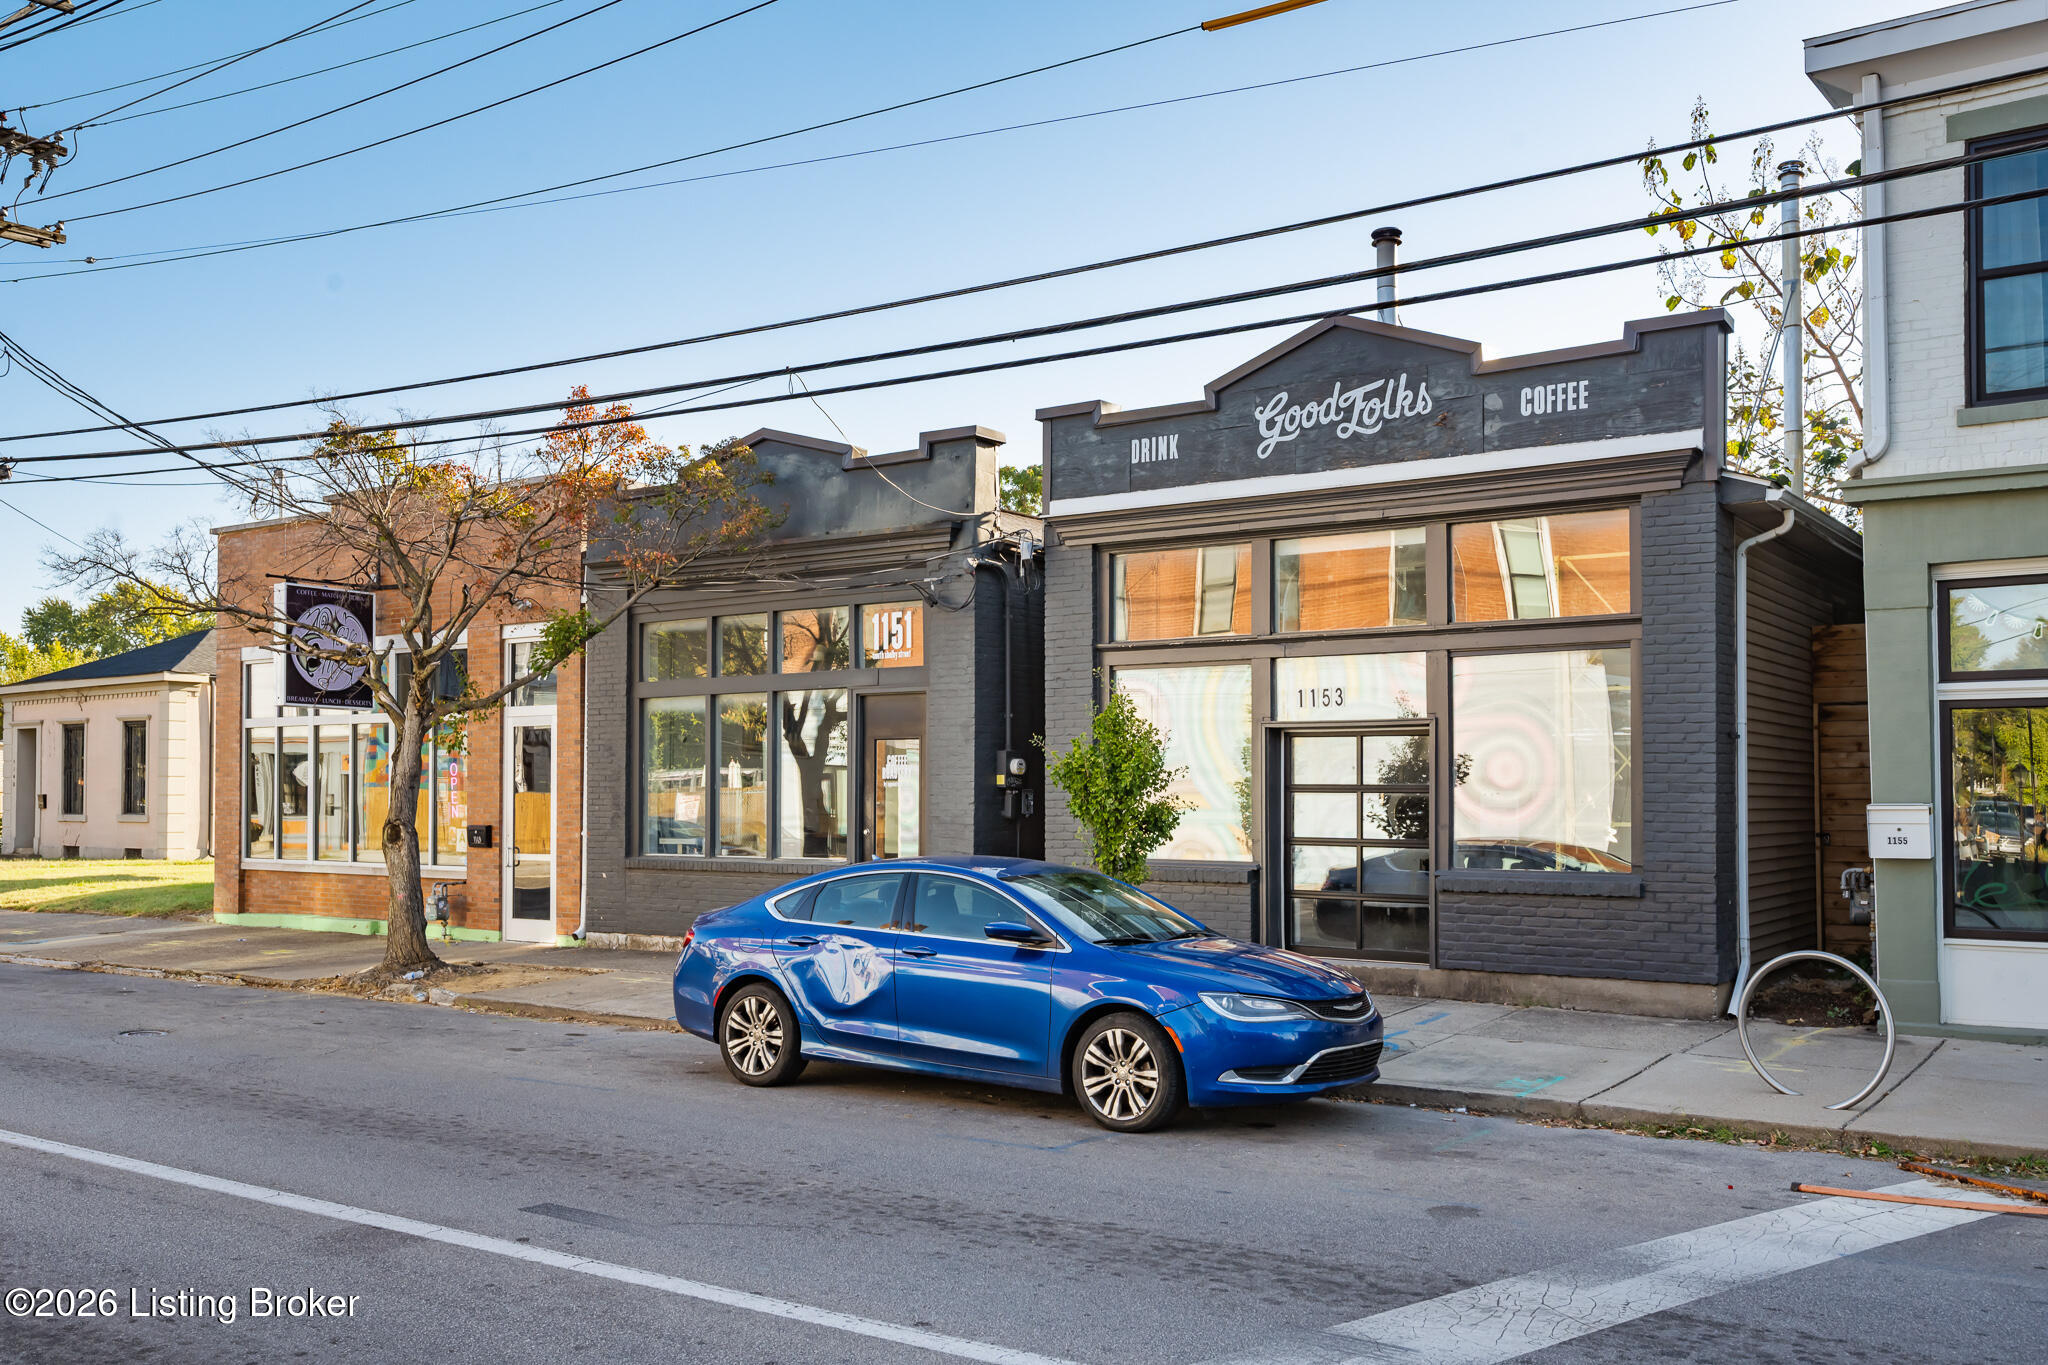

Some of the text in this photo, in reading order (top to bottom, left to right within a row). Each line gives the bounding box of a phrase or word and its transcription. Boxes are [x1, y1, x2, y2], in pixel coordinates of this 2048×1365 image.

[1520, 380, 1589, 417] COFFEE
[1255, 373, 1433, 460] Good Folks
[1131, 433, 1179, 464] DRINK
[296, 588, 318, 597] COFFEE
[872, 610, 912, 650] 1151
[286, 695, 318, 703] BREAKFAST
[322, 697, 342, 705] LUNCH
[1298, 687, 1344, 708] 1153
[449, 762, 459, 819] OPEN
[1887, 836, 1908, 846] 1155
